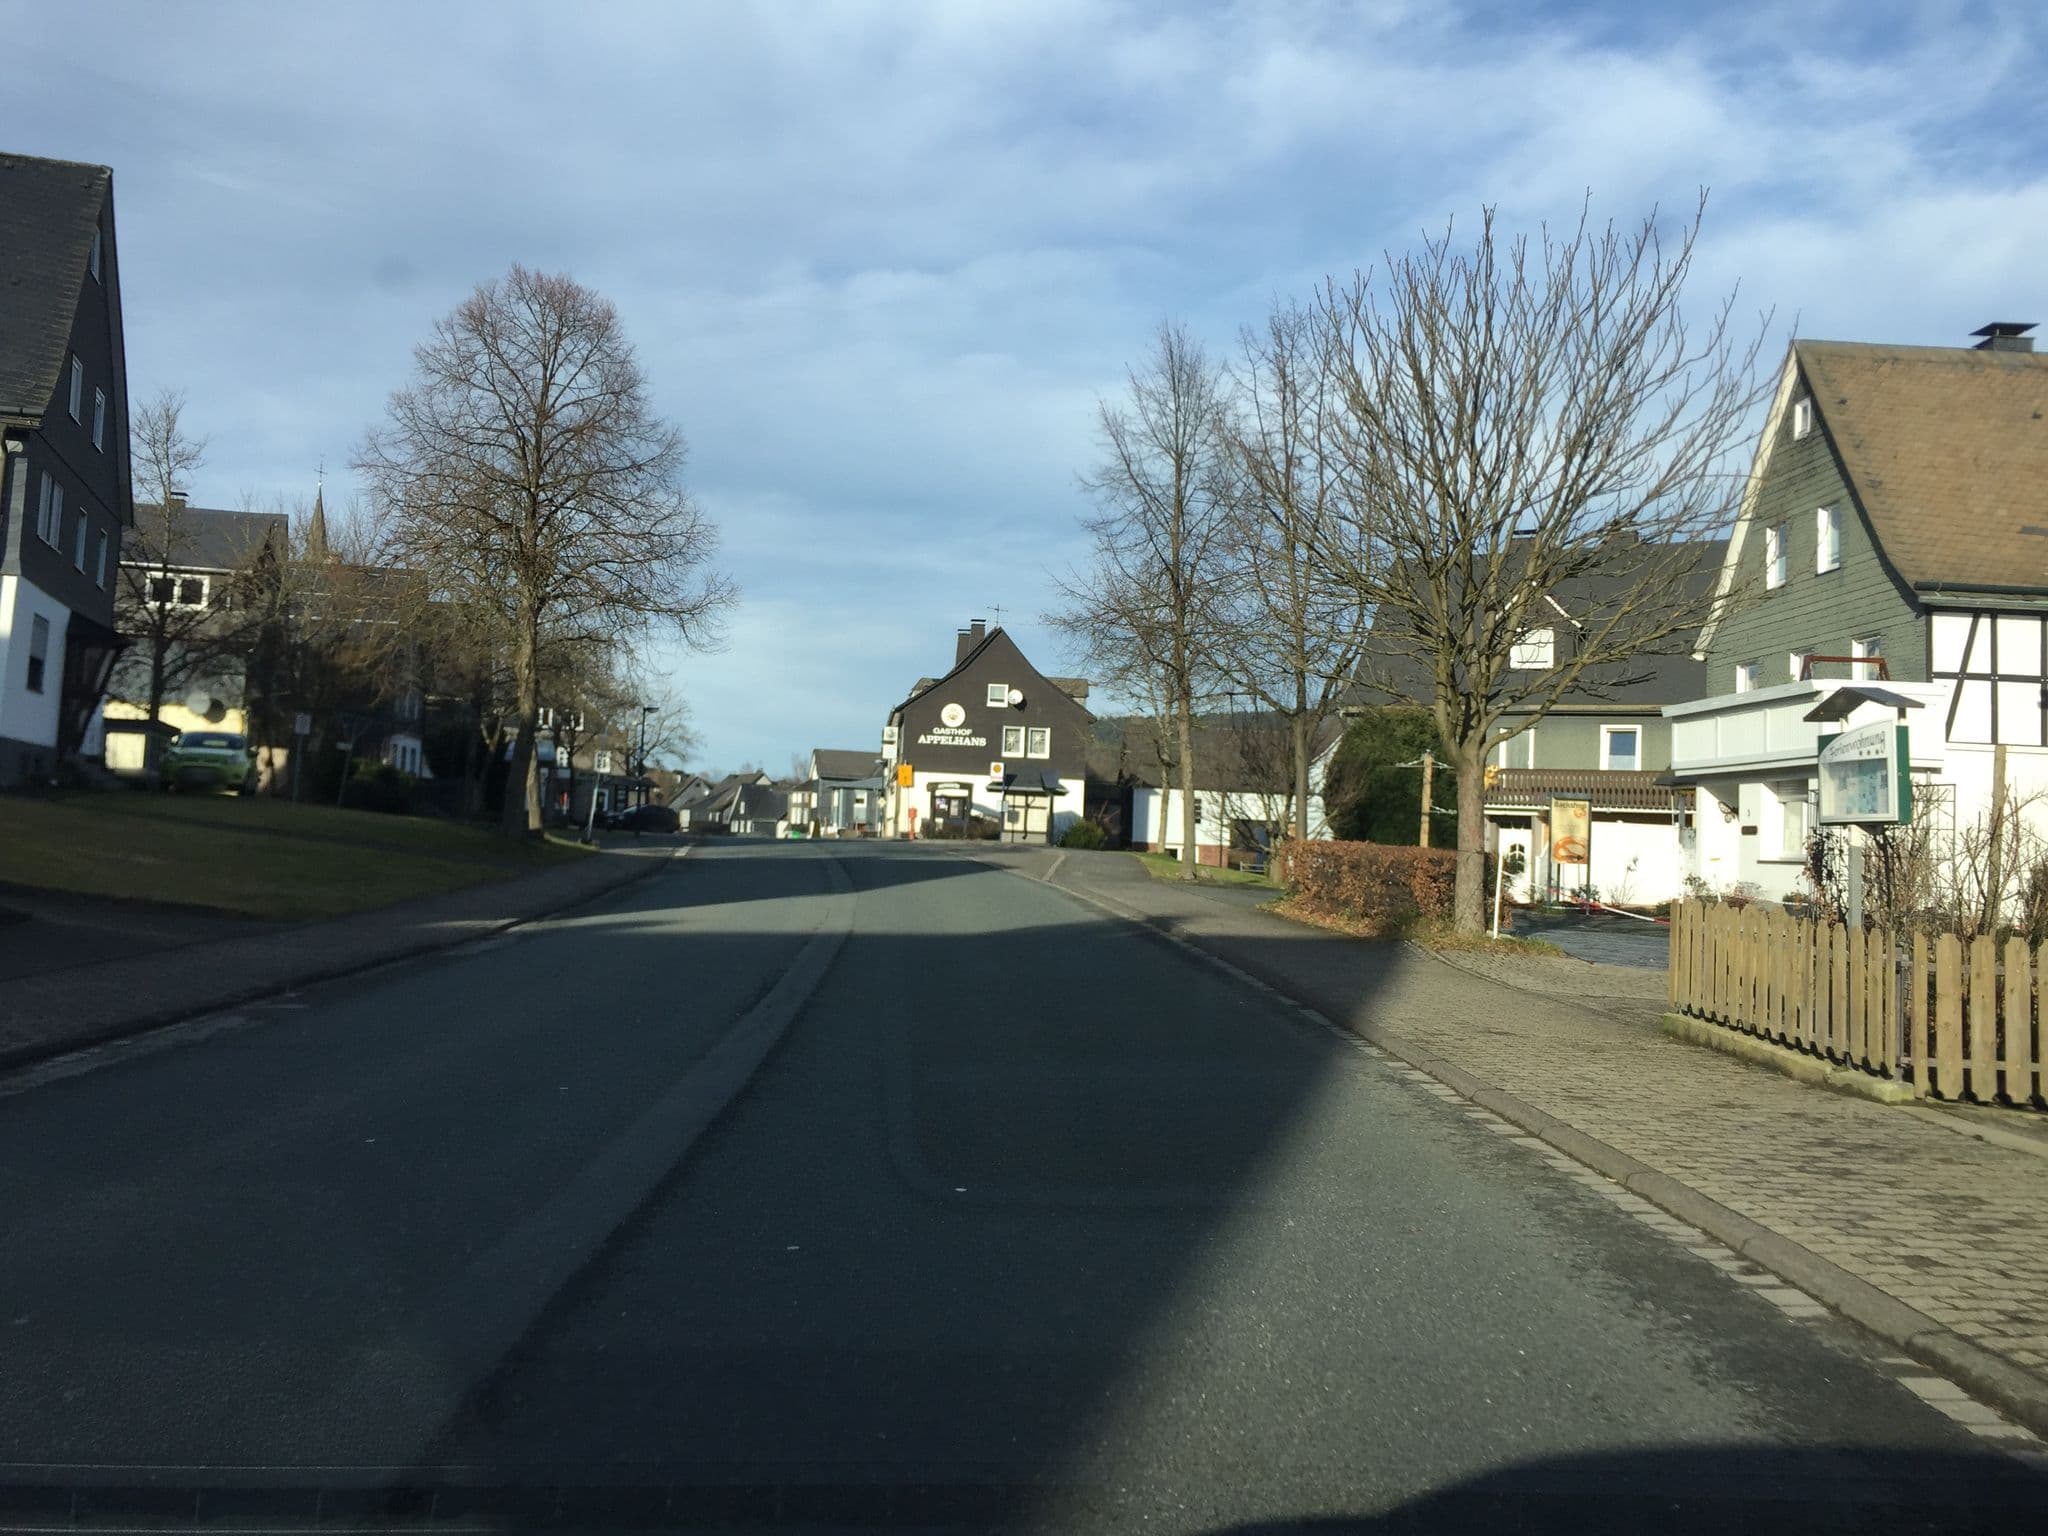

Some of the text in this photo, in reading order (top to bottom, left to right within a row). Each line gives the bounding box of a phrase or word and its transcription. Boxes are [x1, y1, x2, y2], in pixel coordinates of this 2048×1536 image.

[932, 727, 973, 736] GASTHOF
[917, 734, 987, 747] APPELHANS
[1829, 730, 1886, 755] Ferienwohnung
